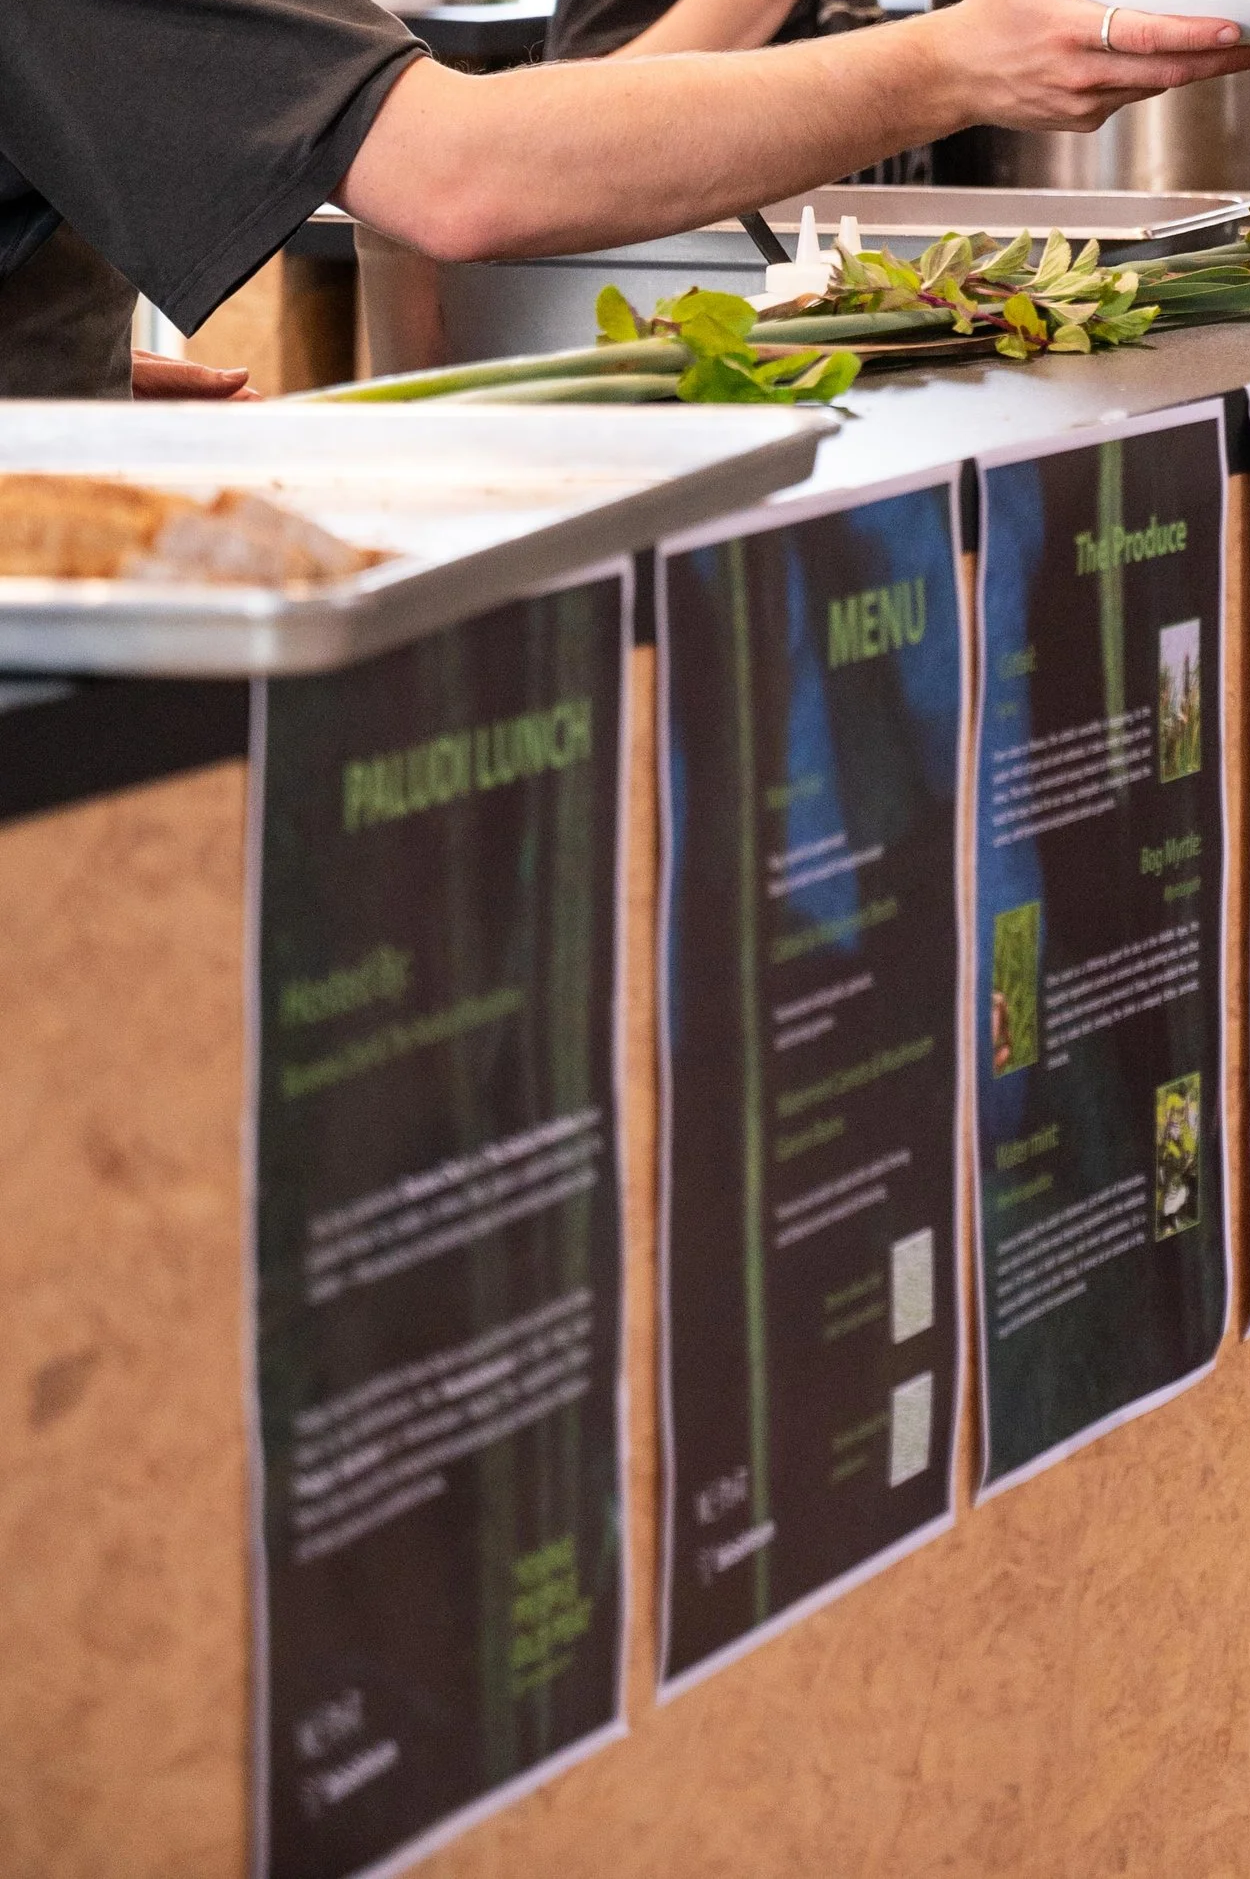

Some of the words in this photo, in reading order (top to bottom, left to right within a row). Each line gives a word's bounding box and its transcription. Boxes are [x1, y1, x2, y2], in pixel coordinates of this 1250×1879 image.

[1075, 531, 1110, 576] The
[1112, 515, 1188, 567] Produce
[827, 576, 927, 670] MENU
[473, 697, 593, 789] LUNCH
